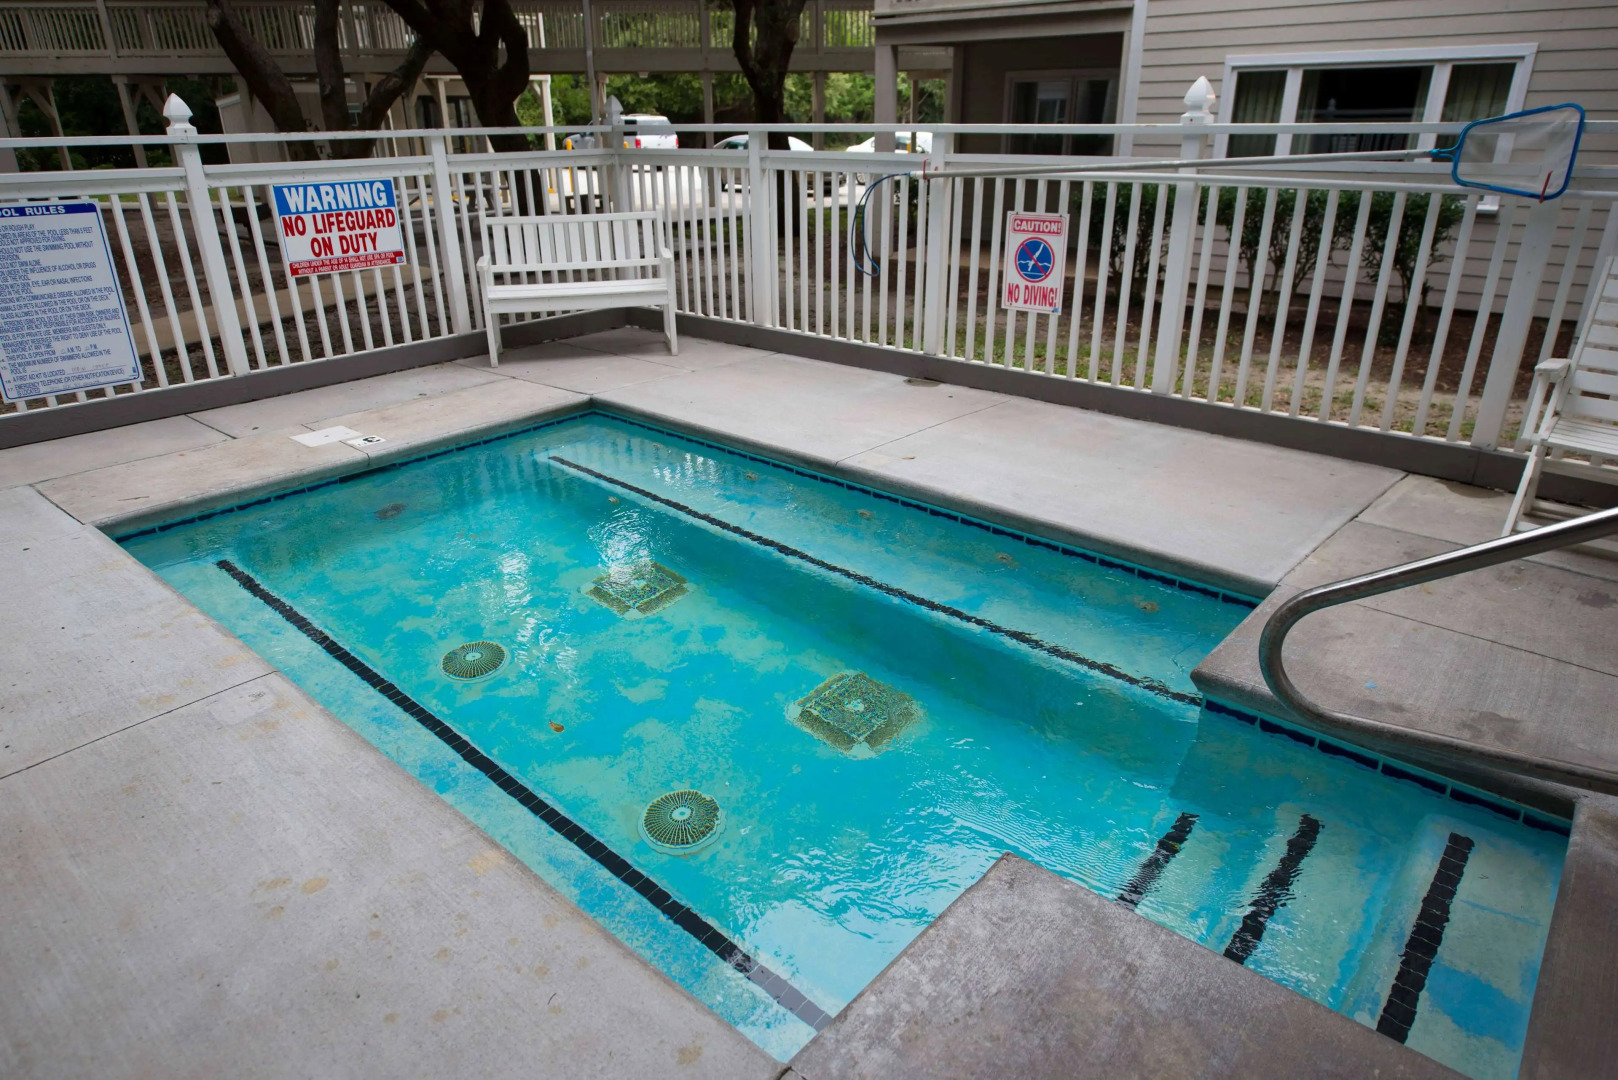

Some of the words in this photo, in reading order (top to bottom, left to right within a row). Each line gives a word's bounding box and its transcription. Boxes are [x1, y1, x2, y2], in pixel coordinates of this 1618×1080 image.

[282, 182, 388, 213] WARNING
[25, 205, 65, 216] RULES
[282, 215, 306, 237] NO
[312, 208, 395, 234] LIFEGUARD
[1014, 220, 1061, 232] CAUTION!
[310, 236, 334, 258] ON
[339, 232, 377, 254] DUTY
[1008, 283, 1020, 303] NO
[1023, 285, 1058, 308] DIVING!
